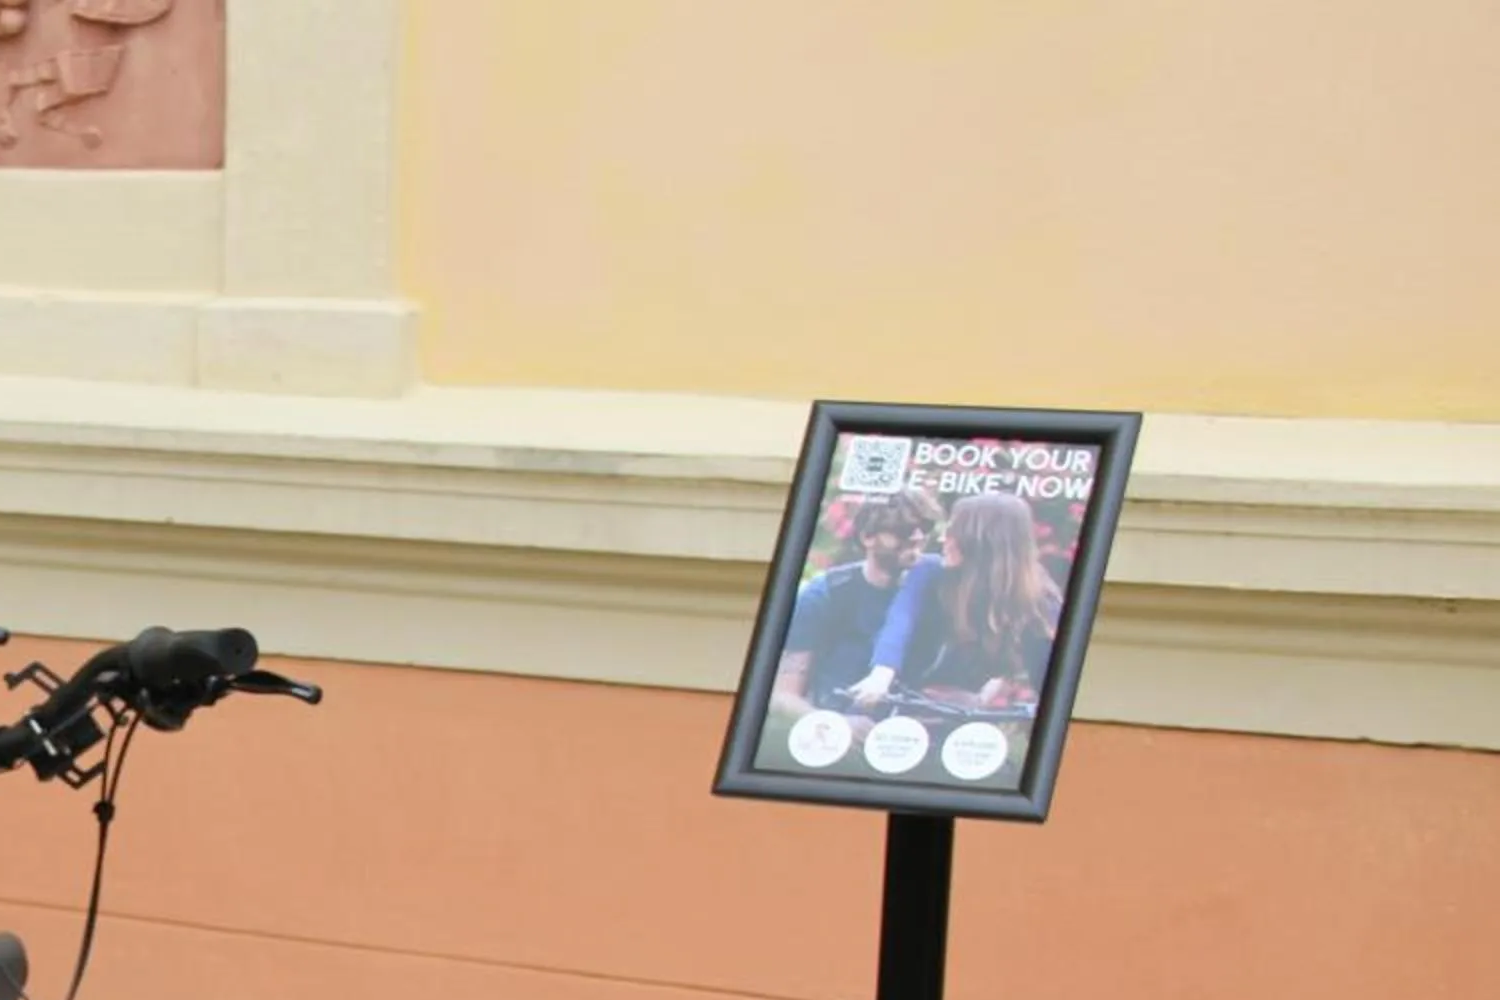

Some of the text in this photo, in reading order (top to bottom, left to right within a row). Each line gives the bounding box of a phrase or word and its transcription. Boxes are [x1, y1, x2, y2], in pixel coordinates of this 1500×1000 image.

[915, 442, 1092, 471] BOOK YOUR
[907, 470, 1094, 498] E-BIKE NOW
